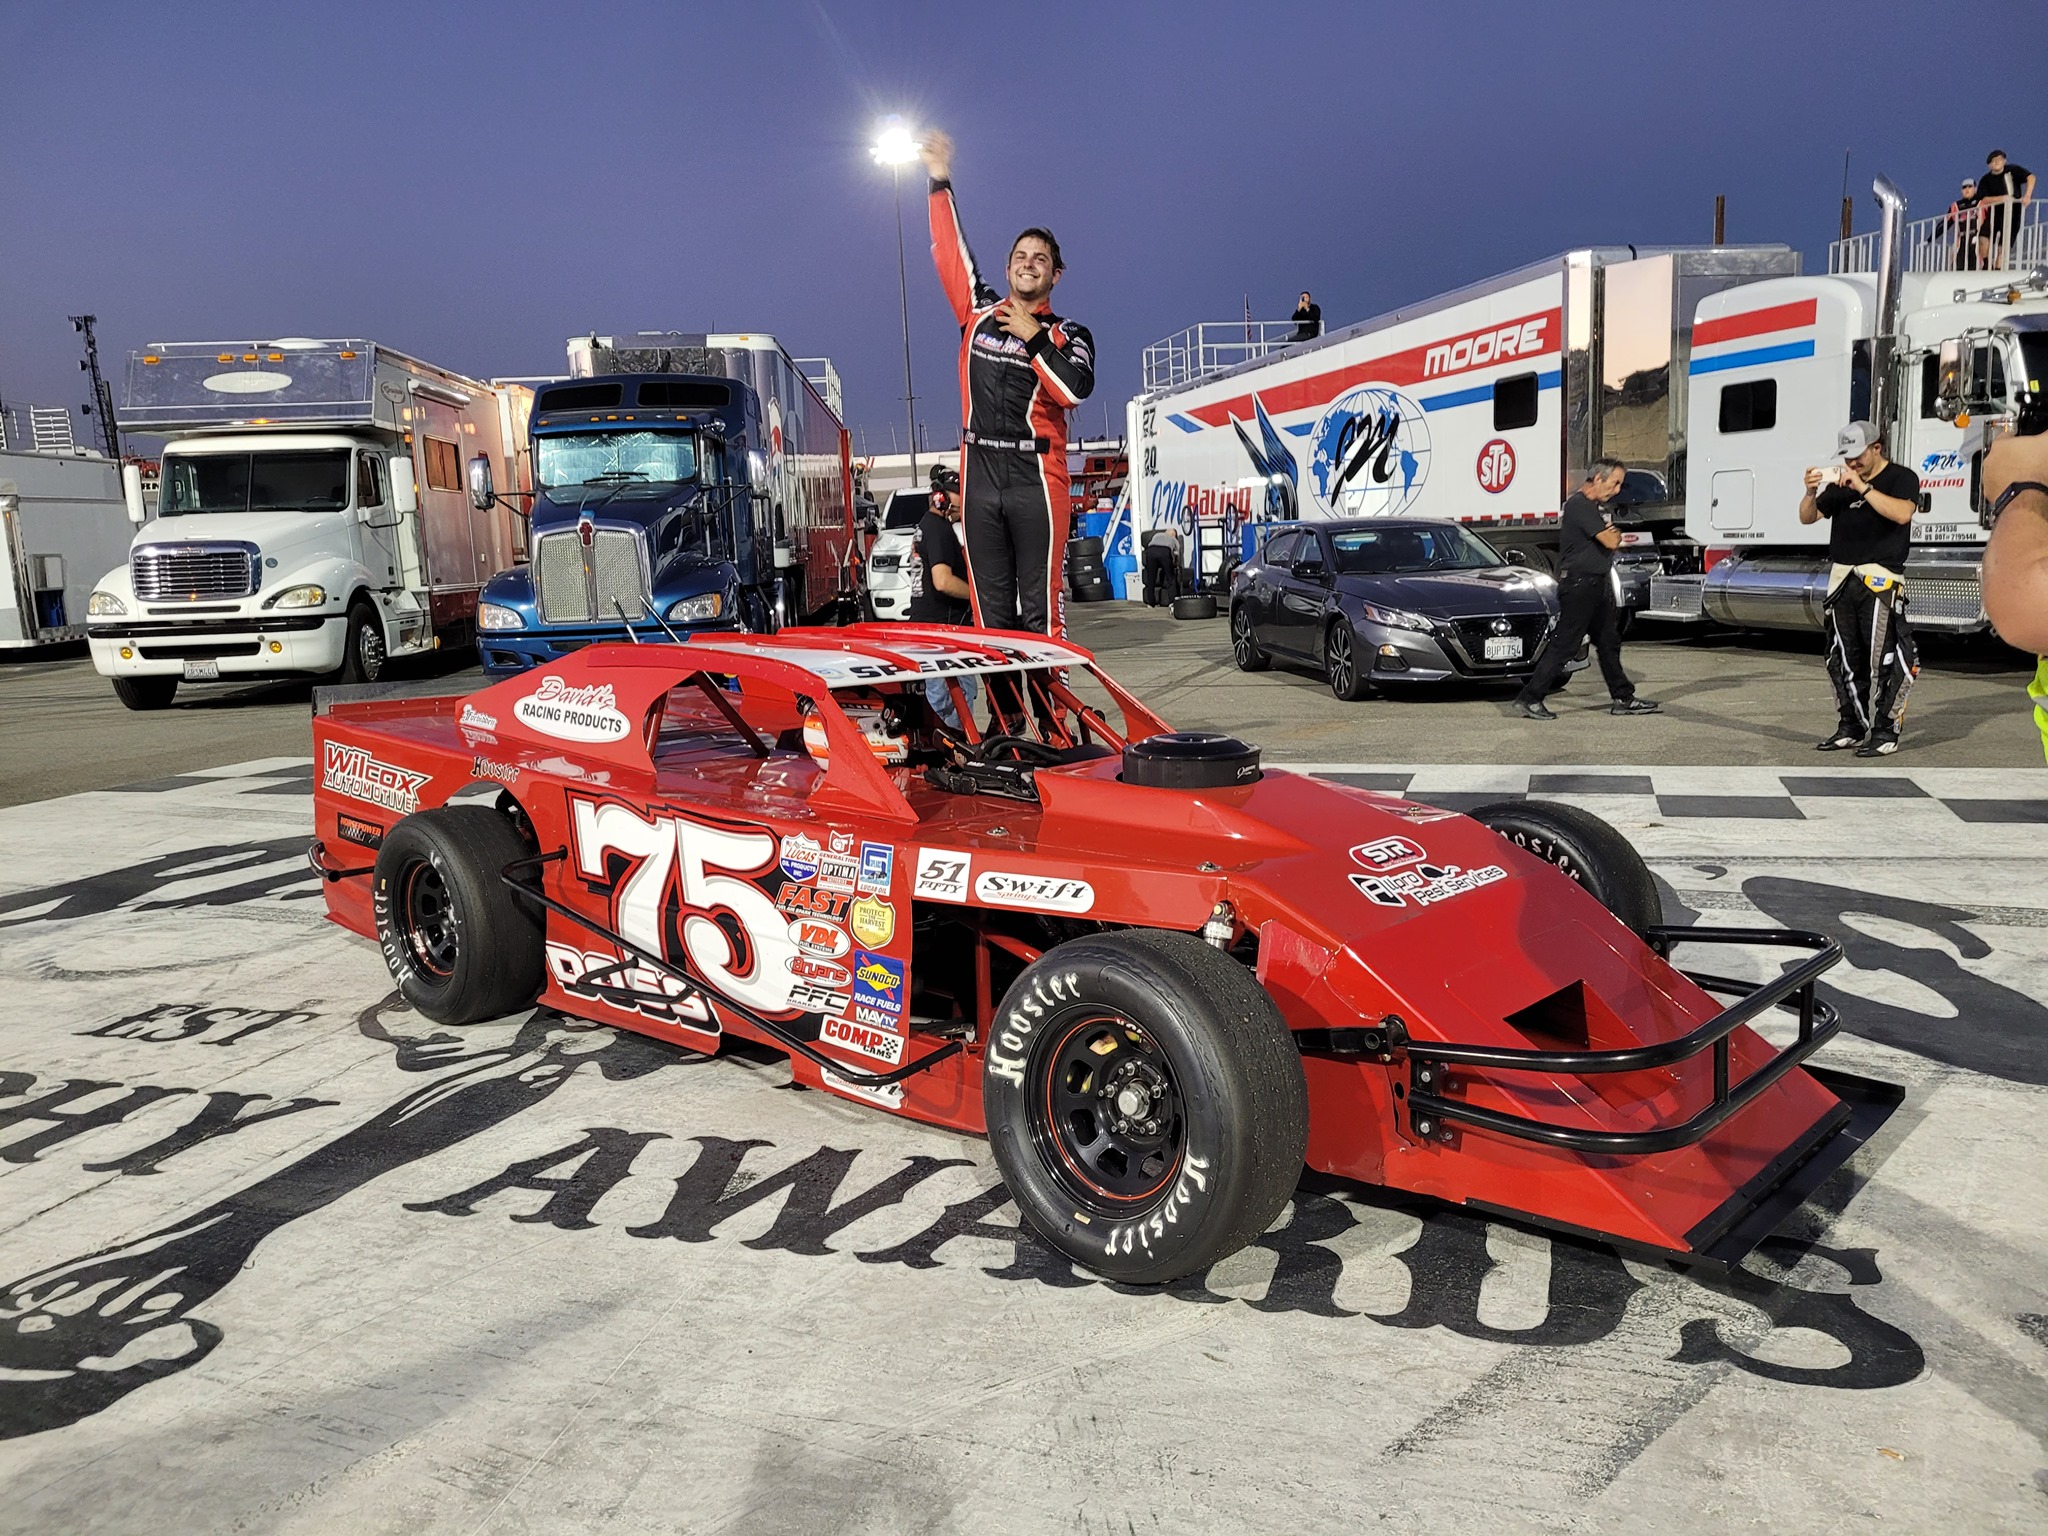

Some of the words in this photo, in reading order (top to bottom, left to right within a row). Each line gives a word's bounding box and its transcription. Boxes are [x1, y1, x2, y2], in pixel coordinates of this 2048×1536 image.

[1424, 317, 1548, 377] MOORE
[1143, 408, 1156, 430] 27
[1145, 446, 1157, 470] 20
[1480, 443, 1513, 488] STP
[1920, 478, 1965, 488] Racing
[1187, 483, 1252, 521] Racing
[536, 679, 614, 711] David's
[522, 703, 561, 721] RACING
[563, 710, 622, 733] PRODUCTS
[326, 744, 419, 797] Wilcox
[471, 755, 520, 784] Hoosier
[323, 772, 414, 814] AUTOMOTIVE
[340, 816, 382, 837] HORSEPOWER
[785, 847, 818, 863] LUCAS
[819, 851, 845, 862] GENERAL
[1361, 840, 1413, 865] STR
[790, 862, 817, 873] PRODUCTS
[822, 863, 857, 879] OPTIMA
[920, 860, 966, 883] 51
[861, 884, 877, 893] LUCAS
[917, 881, 964, 894] FIFTY
[983, 876, 1089, 899] Swift
[1413, 881, 1448, 903] Pest
[1446, 866, 1504, 891] Services
[570, 794, 806, 1014] 75
[778, 884, 850, 916] FAST
[859, 906, 886, 918] PROTECT
[811, 911, 844, 923] TECHNOLOGY
[859, 917, 886, 928] HARVEST
[374, 890, 414, 994] Hoosier
[799, 923, 839, 949] VDL
[800, 941, 811, 949] FUEL
[811, 943, 834, 953] SYSTEMS
[791, 956, 848, 982] Bryans
[859, 968, 898, 987] SUNOCO
[788, 984, 850, 1010] PFC
[854, 992, 876, 1006] RACE
[876, 998, 901, 1013] FUELS
[824, 1019, 884, 1048] COMP
[988, 972, 1081, 1089] Hoosier
[862, 1044, 892, 1060] CAMS
[1104, 1150, 1210, 1260] Hoosier
